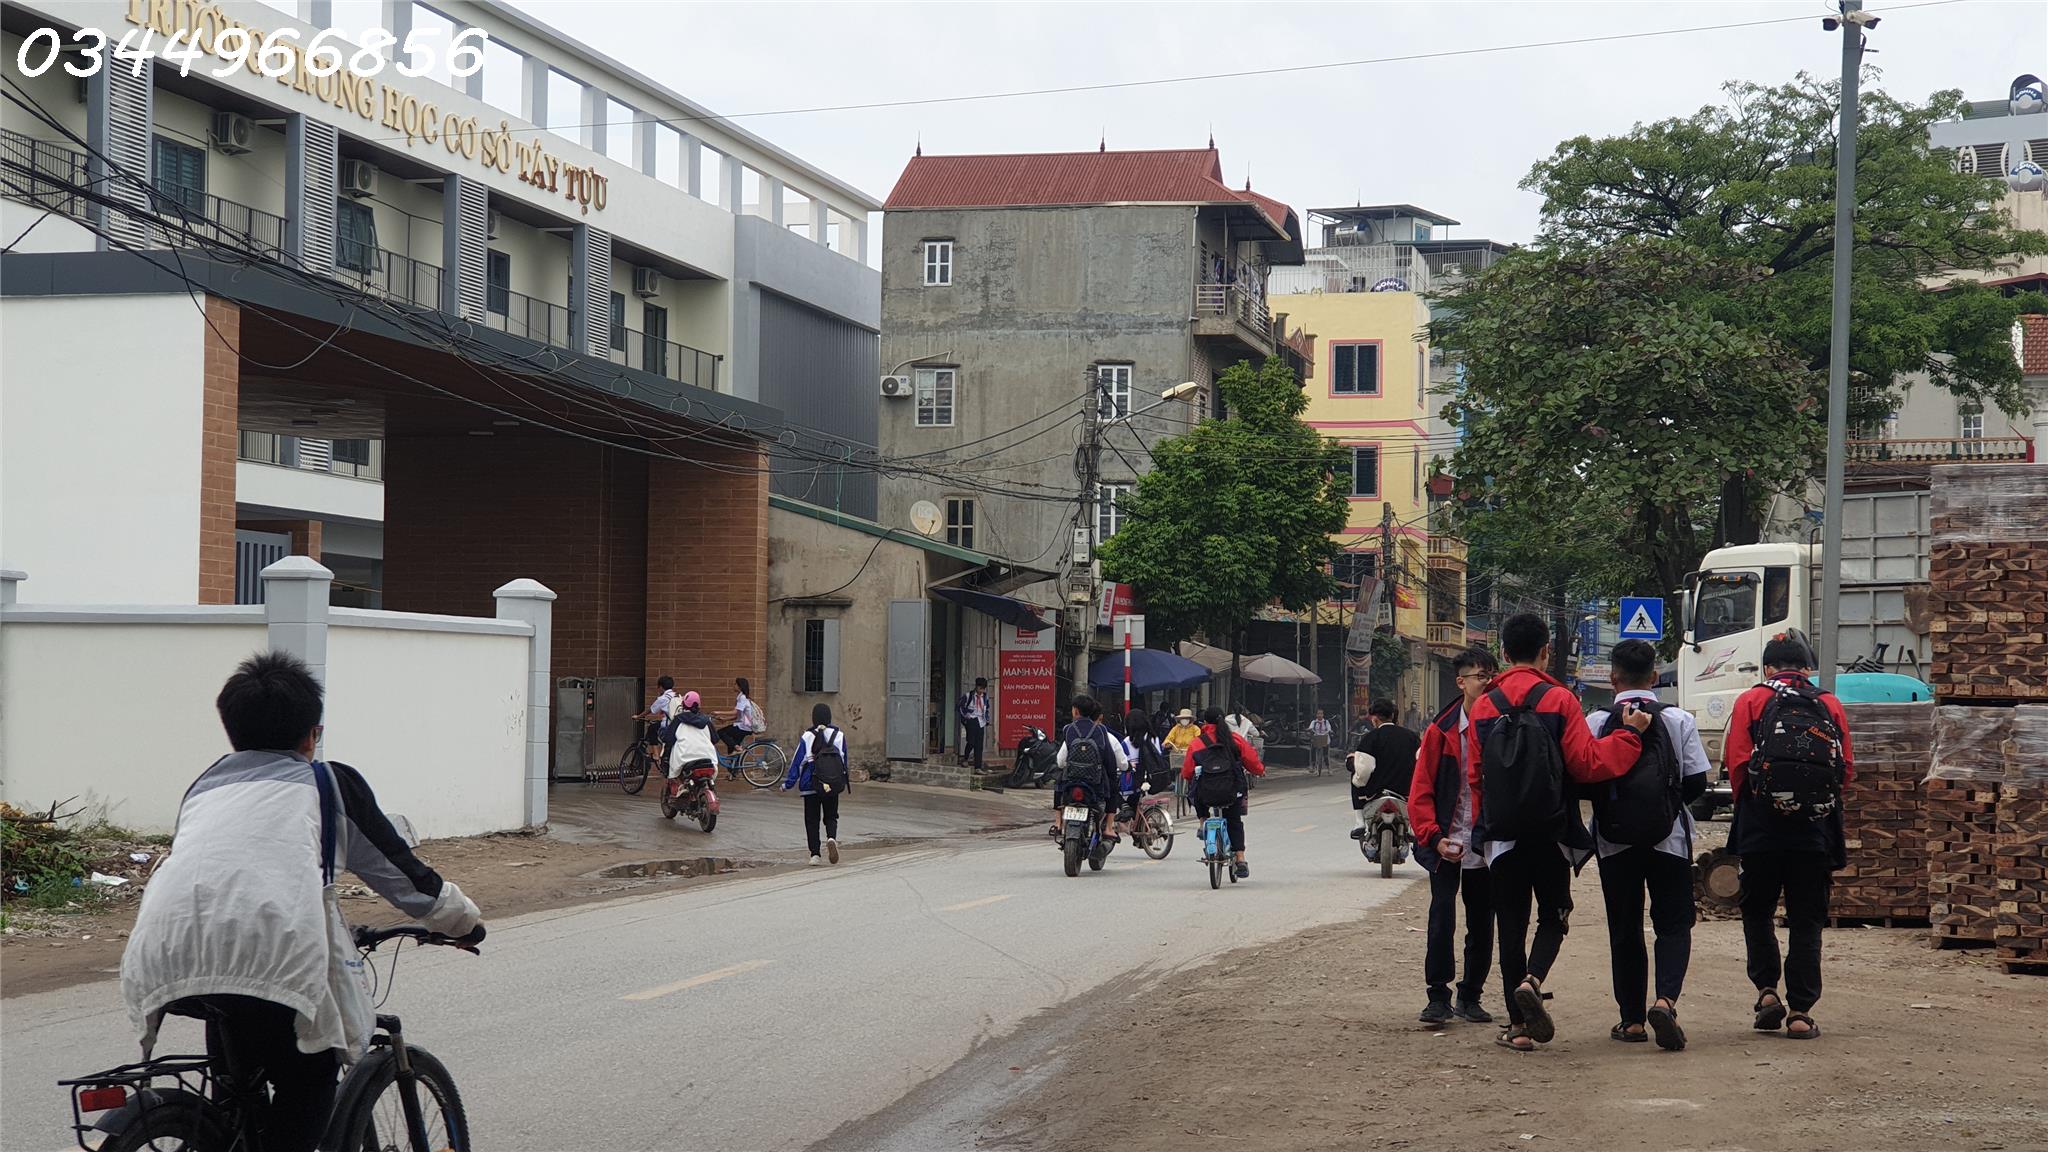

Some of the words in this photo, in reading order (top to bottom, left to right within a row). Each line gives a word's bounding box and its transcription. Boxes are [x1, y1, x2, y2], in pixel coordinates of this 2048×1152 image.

[382, 85, 439, 147] HỌC
[444, 112, 478, 160] CƠ
[481, 119, 513, 174] SỞ
[515, 138, 561, 193] TÂY
